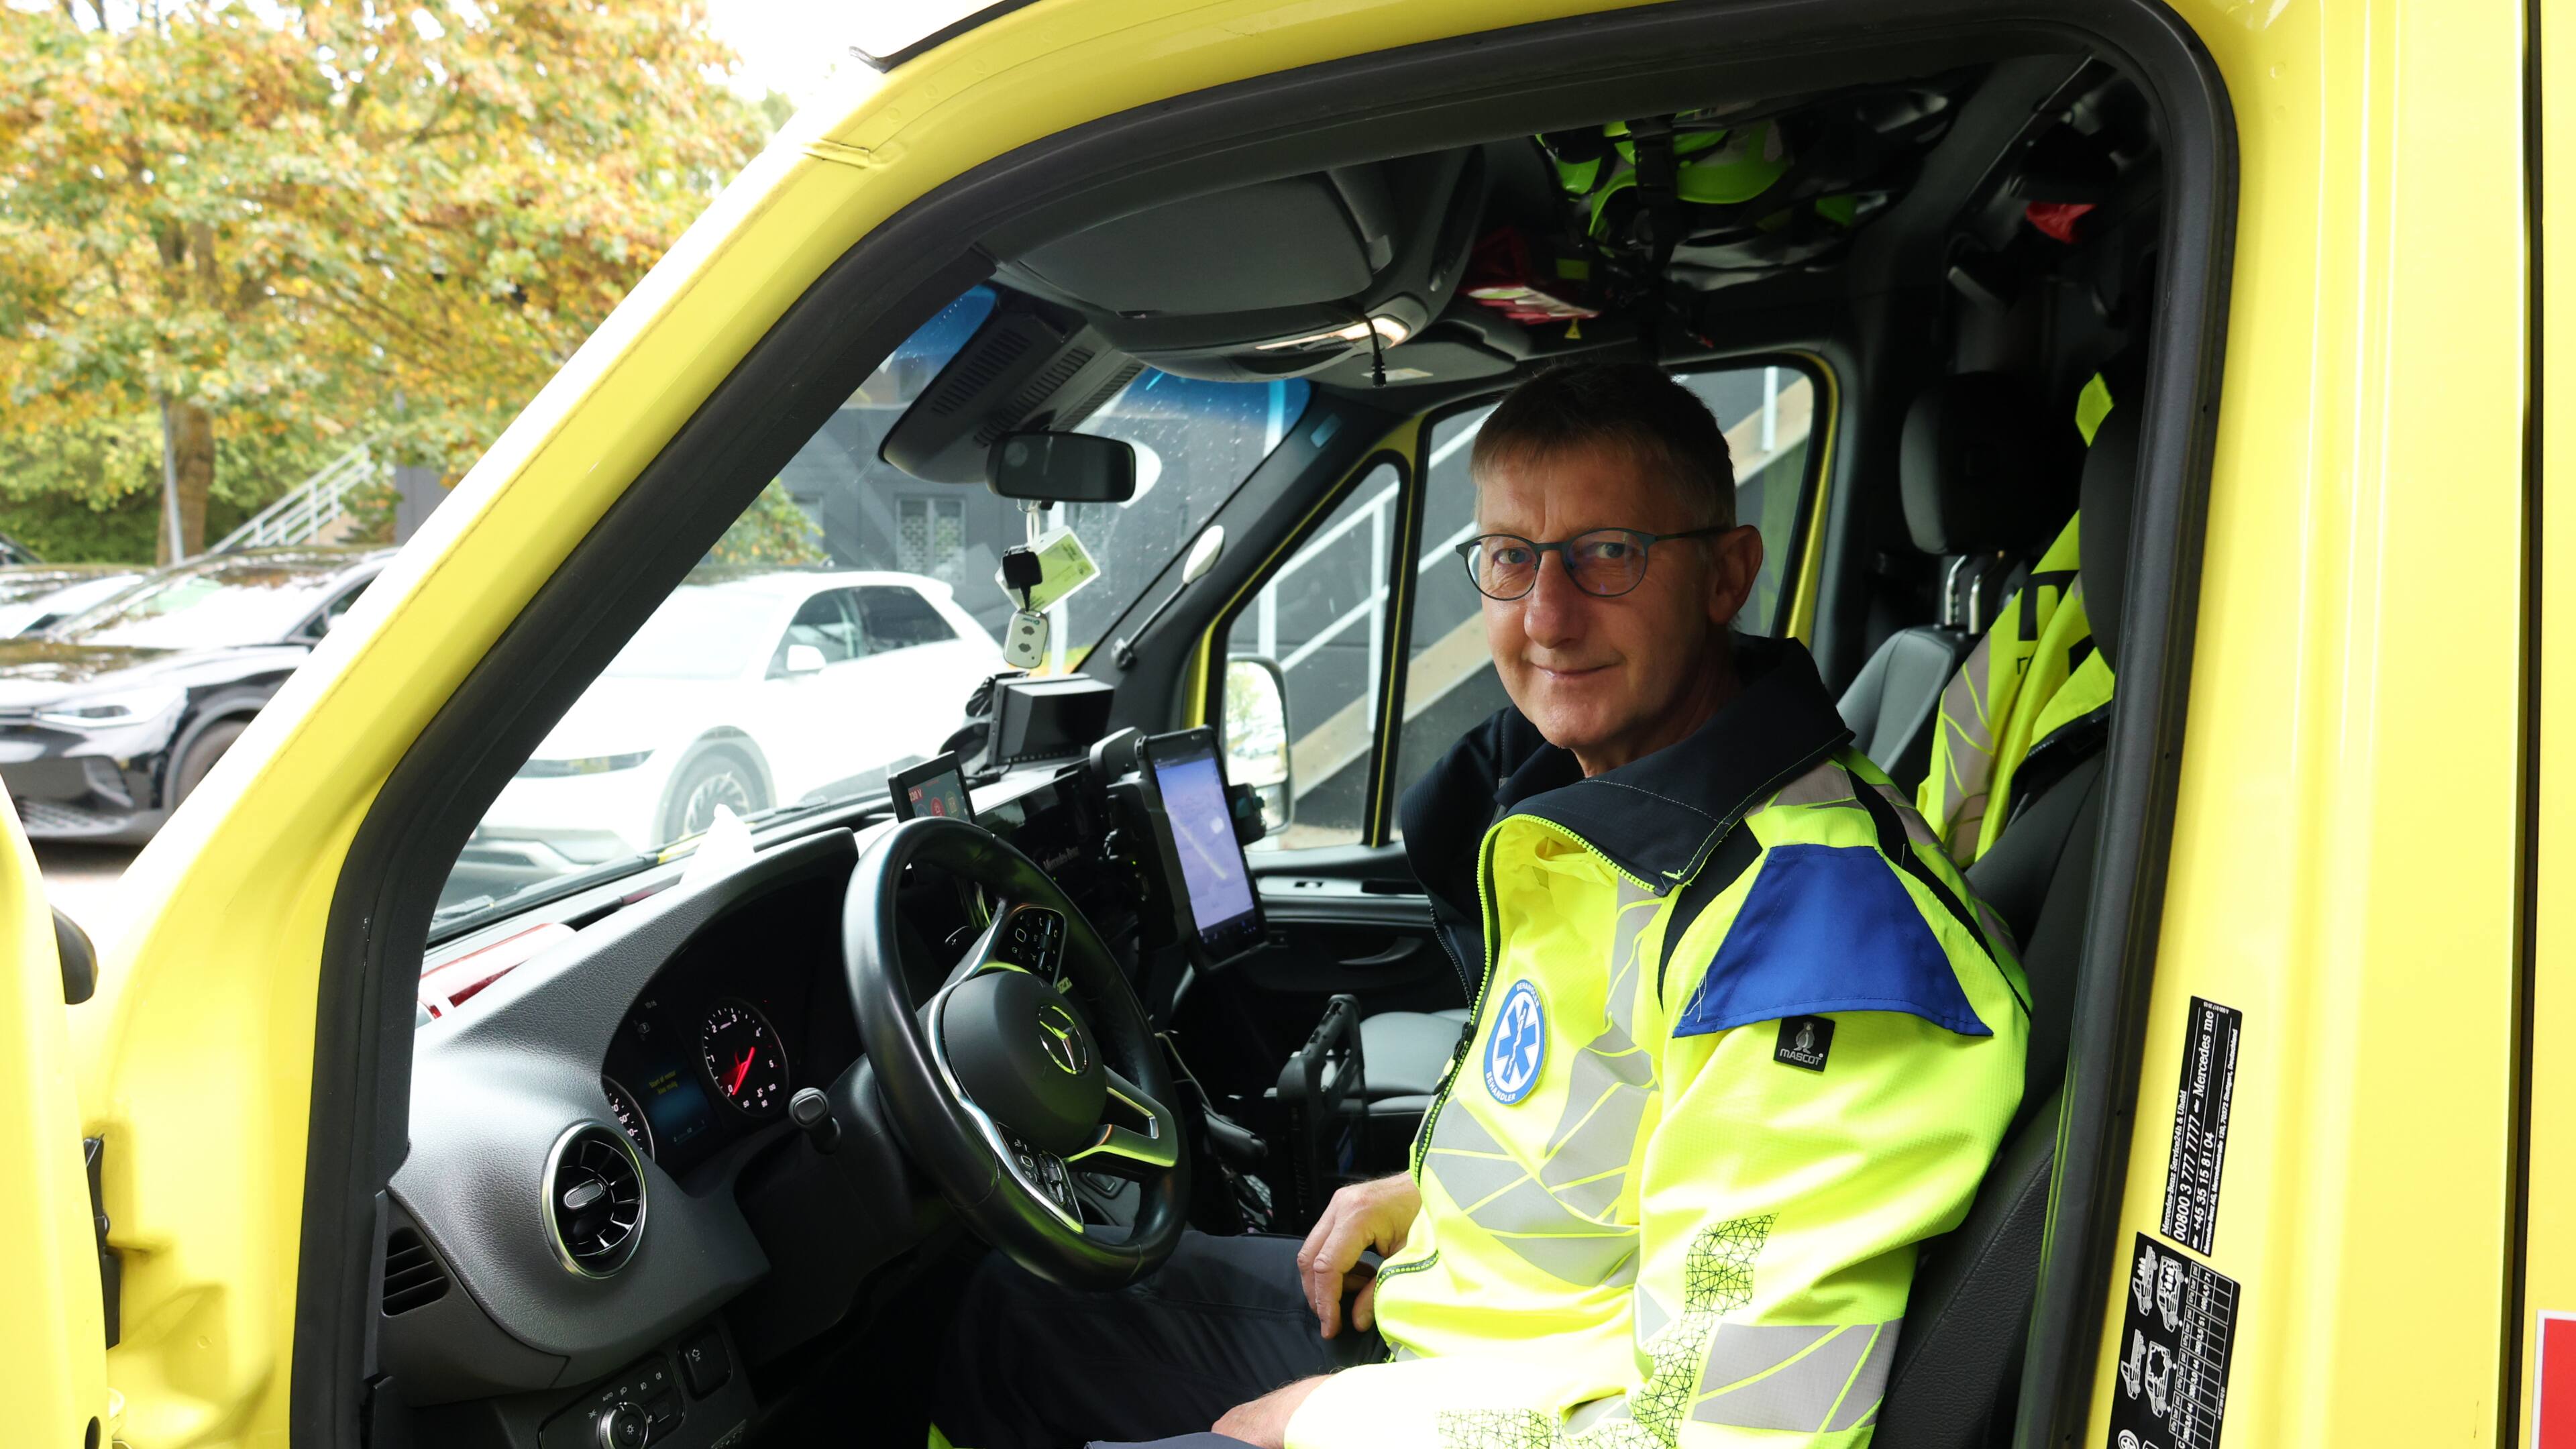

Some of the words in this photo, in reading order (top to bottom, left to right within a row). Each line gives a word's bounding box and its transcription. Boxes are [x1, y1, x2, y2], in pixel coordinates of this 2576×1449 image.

[1516, 983, 1540, 1008] BEHANDLER
[732, 1014, 737, 1022] 3
[2204, 1010, 2214, 1032] me
[712, 1025, 717, 1033] 2
[769, 1060, 774, 1068] 5
[1780, 1049, 1822, 1065] MASCOT
[2192, 1034, 2211, 1098] Mercedes
[728, 1084, 733, 1093] 0
[1486, 1071, 1516, 1102] BEHANDLER
[2185, 1114, 2200, 1152] 7777
[2204, 1132, 2214, 1148] 04
[2181, 1152, 2196, 1183] 777
[2201, 1151, 2212, 1167] 81
[2199, 1169, 2209, 1184] 15
[2180, 1183, 2192, 1195] 3
[2196, 1187, 2207, 1205] 35
[2162, 1172, 2176, 1234] Mercedes-Benz
[2174, 1196, 2190, 1241] 00800
[2194, 1206, 2204, 1230] +45
[2199, 1316, 2205, 1326] 51
[2204, 1272, 2211, 1283] 71
